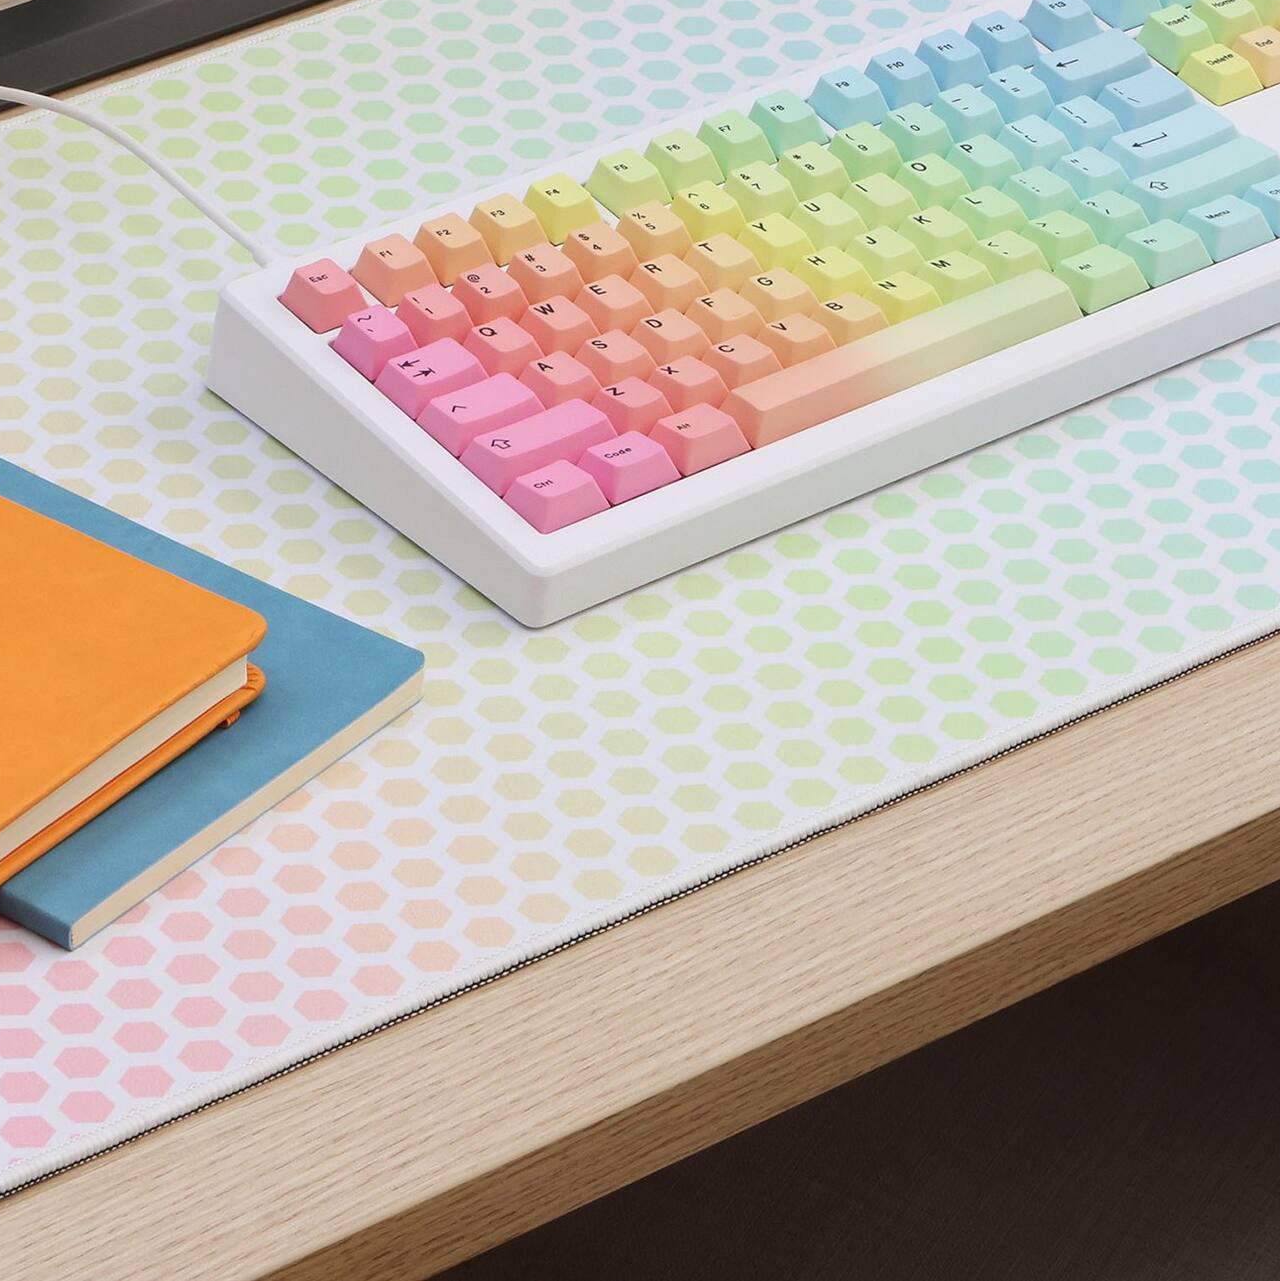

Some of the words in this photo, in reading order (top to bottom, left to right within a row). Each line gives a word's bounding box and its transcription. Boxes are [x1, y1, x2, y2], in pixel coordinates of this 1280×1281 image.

[1049, 1, 1066, 10] F13
[1165, 14, 1190, 26] Insert
[987, 24, 1005, 33] F12
[937, 43, 954, 52] F11
[1255, 39, 1273, 47] End
[1206, 53, 1234, 65] Delete
[886, 61, 904, 70] F10
[835, 81, 850, 89] F9
[770, 104, 785, 112] F8
[718, 125, 731, 133] F7
[910, 124, 920, 132] 0
[960, 144, 973, 153] P
[911, 162, 927, 172] O
[545, 188, 560, 196] F4
[855, 183, 868, 193] I
[804, 203, 821, 212] U
[490, 209, 505, 218] F3
[632, 212, 646, 220] %
[1205, 210, 1230, 219] Menu
[913, 215, 932, 225] K
[645, 222, 656, 230] 5
[752, 222, 767, 232] Y
[436, 229, 451, 237] F2
[578, 233, 589, 241] $
[866, 236, 877, 245] J
[698, 242, 713, 253] T
[379, 250, 393, 258] F1
[524, 254, 536, 263] #
[808, 256, 826, 266] H
[931, 260, 951, 269] M
[644, 263, 662, 274] R
[1078, 263, 1092, 271] Alt
[309, 274, 328, 283] Esc
[467, 274, 480, 283] @
[757, 277, 773, 286] G
[480, 286, 492, 294] 2
[878, 281, 897, 290] N
[589, 285, 607, 296] E
[702, 297, 714, 308] F
[825, 302, 843, 311] B
[425, 307, 434, 315] 1
[534, 303, 555, 316] W
[645, 319, 663, 329] D
[771, 322, 787, 331] V
[479, 327, 498, 337] Q
[592, 340, 608, 349] S
[718, 345, 735, 353] C
[538, 362, 554, 372] A
[661, 366, 679, 375] X
[606, 387, 625, 396] Z
[676, 423, 690, 431] Alt
[604, 447, 632, 459] Code
[533, 479, 554, 489] Ctrl
